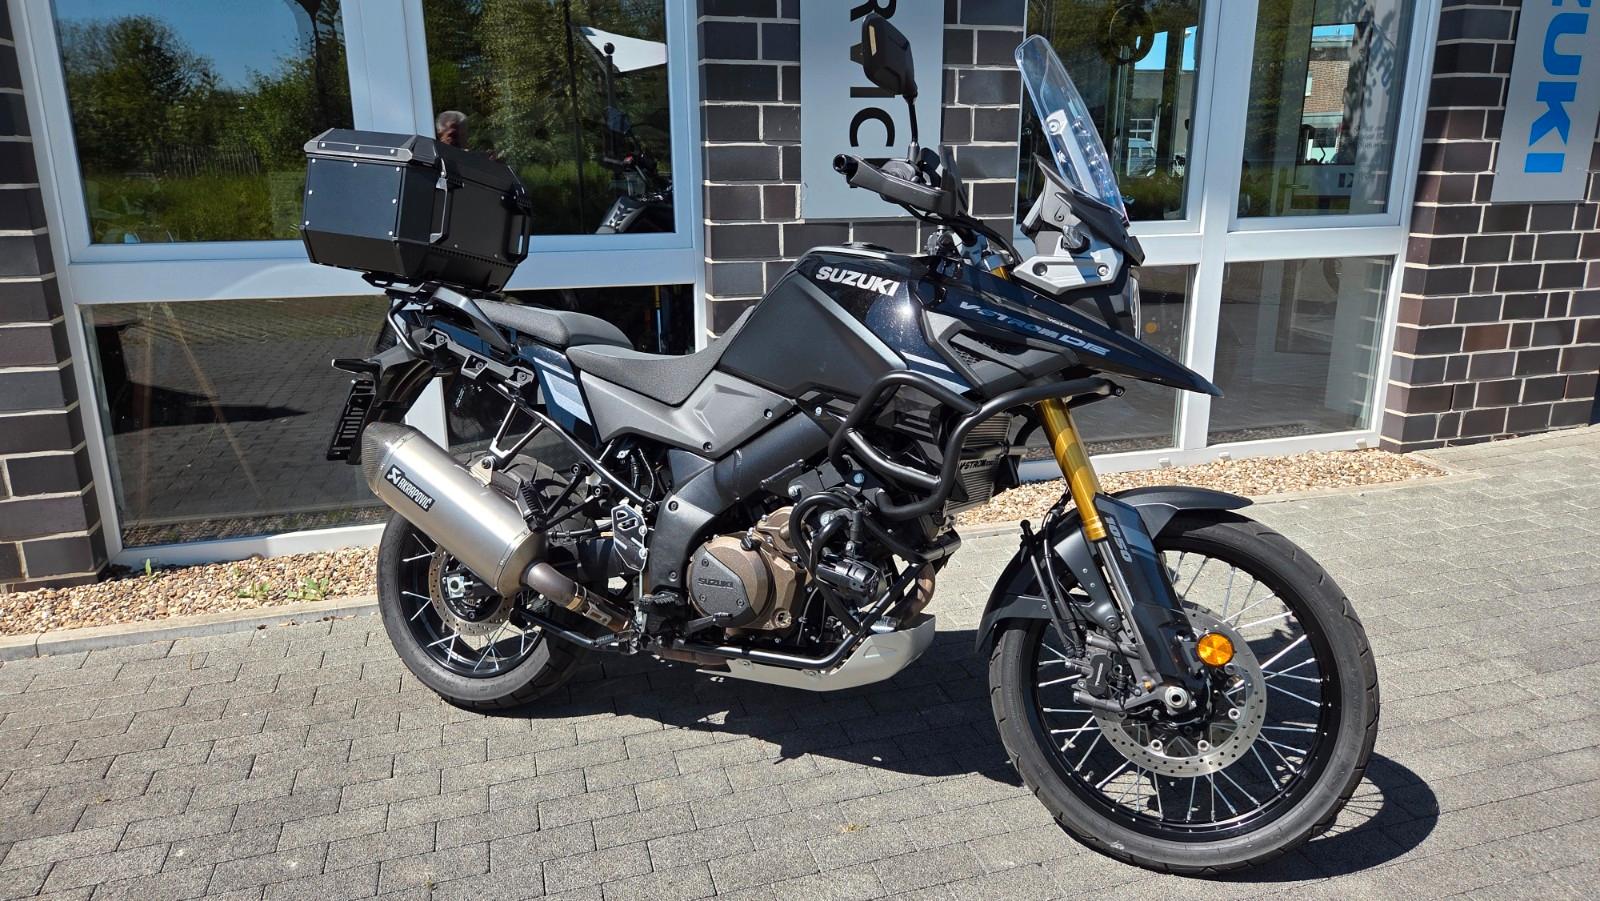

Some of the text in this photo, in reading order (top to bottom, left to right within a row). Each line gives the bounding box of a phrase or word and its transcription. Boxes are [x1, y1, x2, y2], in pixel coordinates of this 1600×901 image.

[815, 265, 901, 297] SUZUKI
[959, 301, 1060, 339] V-STROM
[1058, 334, 1111, 357] DE
[1103, 515, 1133, 564] 1050
[697, 577, 735, 588] SUZUKI
